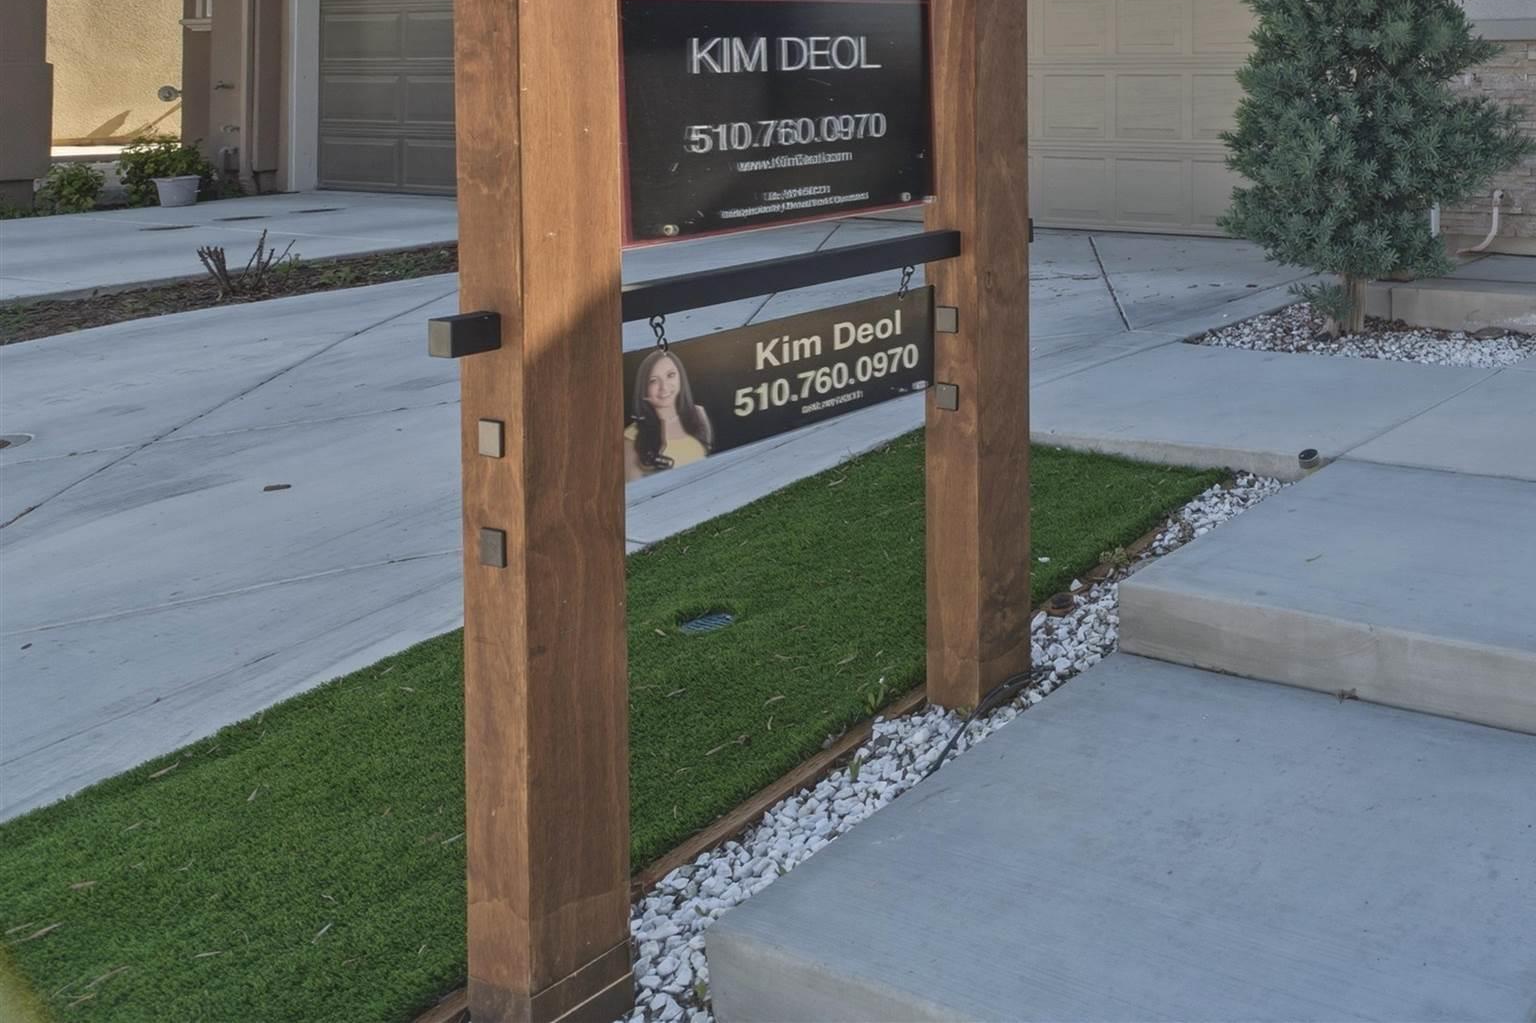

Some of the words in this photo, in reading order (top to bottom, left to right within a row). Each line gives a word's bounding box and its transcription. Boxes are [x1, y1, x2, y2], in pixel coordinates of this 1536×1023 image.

[690, 37, 768, 74] KIM
[779, 36, 882, 72] DEOL
[685, 112, 888, 154] 510.760.0970
[755, 333, 823, 370] Kim
[833, 309, 902, 351] Deol
[733, 343, 919, 418] 510.760.0970
